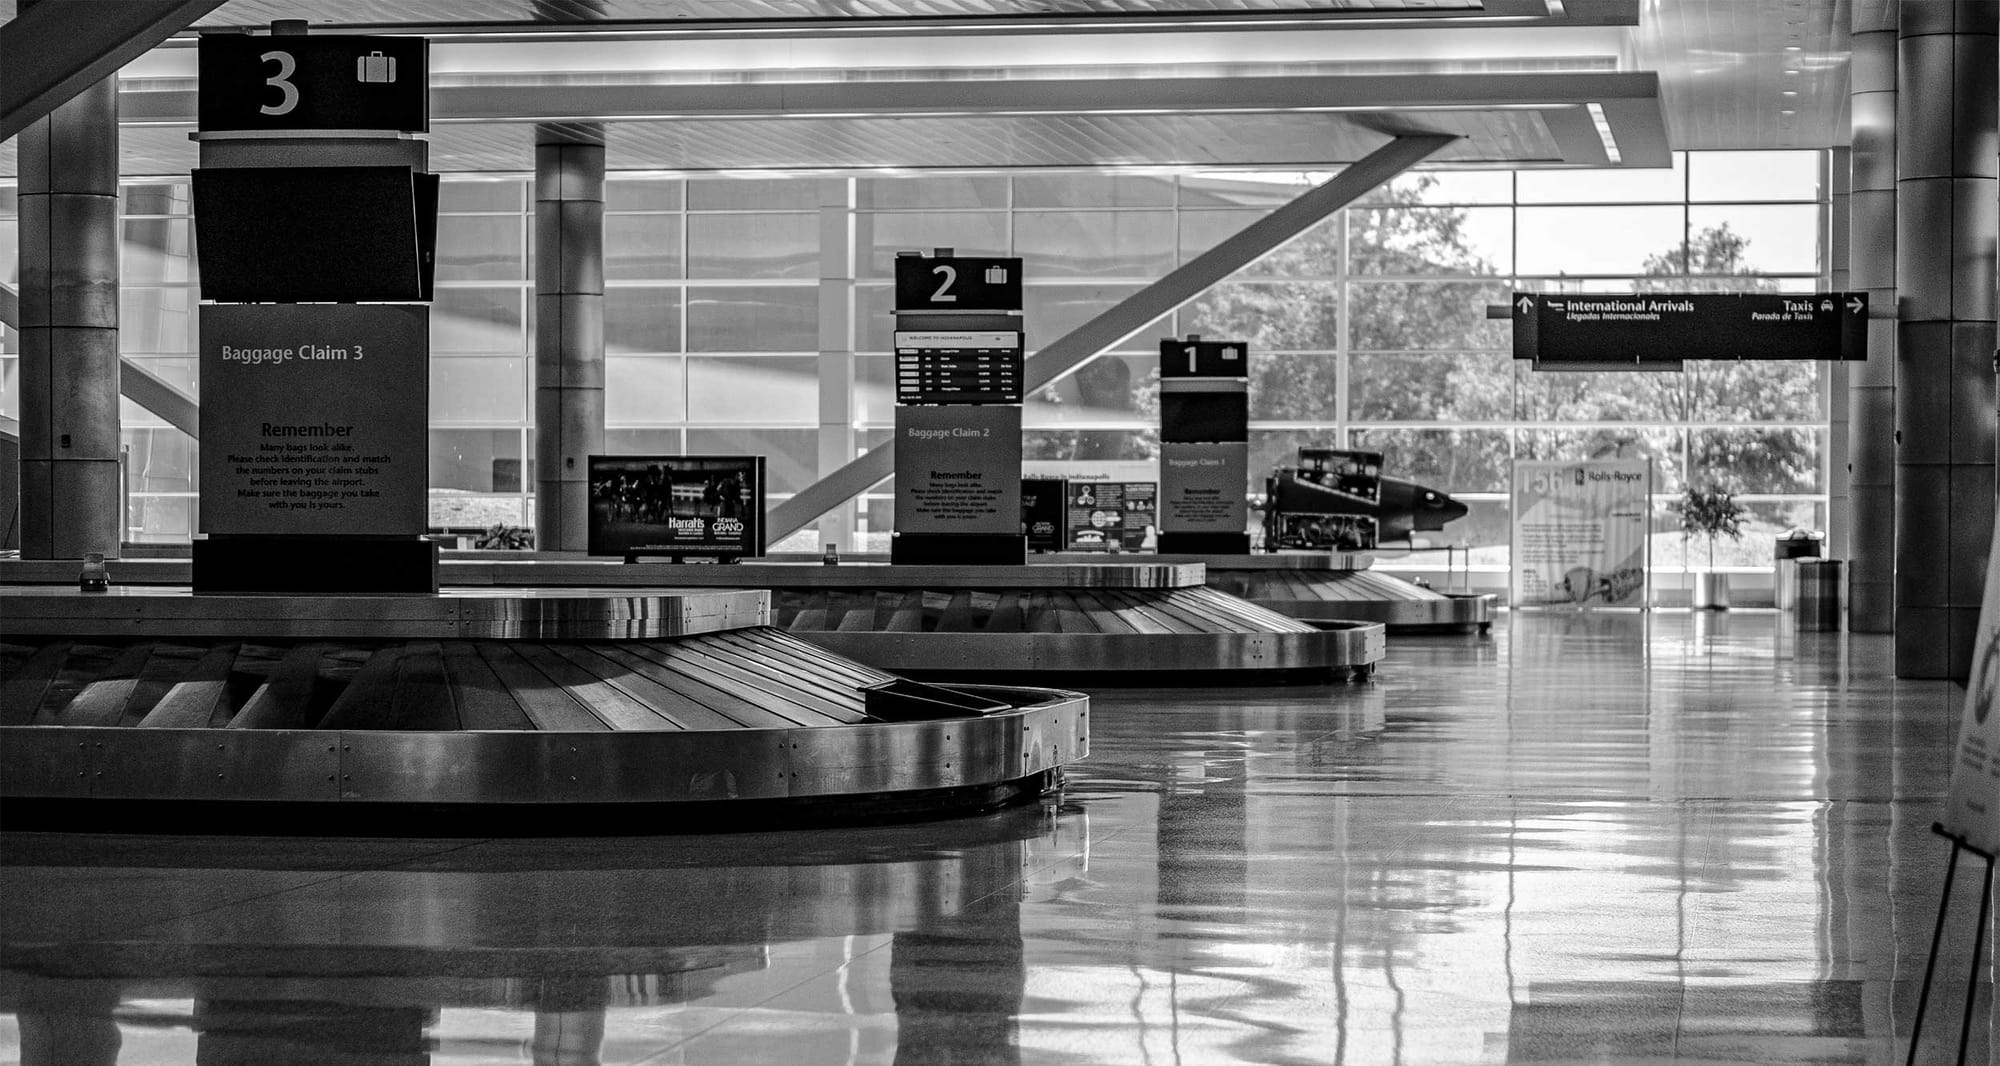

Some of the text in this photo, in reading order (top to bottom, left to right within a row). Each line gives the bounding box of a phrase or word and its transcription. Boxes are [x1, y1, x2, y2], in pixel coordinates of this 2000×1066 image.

[260, 51, 299, 115] 3
[930, 265, 957, 302] 2
[1567, 300, 1694, 311] International Arrivals
[1783, 300, 1813, 312] Taxis
[1566, 312, 1660, 322] Llegadas Internacionales
[1752, 312, 1780, 320] Parada
[1782, 312, 1791, 320] de
[222, 345, 363, 364] Baggage Claim 3
[1184, 346, 1197, 373] 1
[262, 422, 353, 437] Remember
[908, 428, 990, 439] Baggage Claim 2
[260, 444, 284, 453] Many
[287, 444, 307, 453] bags
[227, 455, 391, 463] Please check identification and match
[236, 466, 250, 474] the
[252, 466, 290, 474] numbers
[305, 468, 326, 476] your
[329, 466, 352, 474] claim
[355, 466, 379, 474] stubs
[931, 470, 982, 480] Remember
[250, 478, 365, 487] before leaving the airport.
[237, 489, 261, 497] Make
[283, 489, 297, 497] the
[300, 489, 339, 499] baggage
[341, 491, 358, 499] you
[361, 489, 380, 497] take
[269, 501, 288, 509] with
[310, 501, 317, 509] is
[712, 522, 744, 532] GRAND
